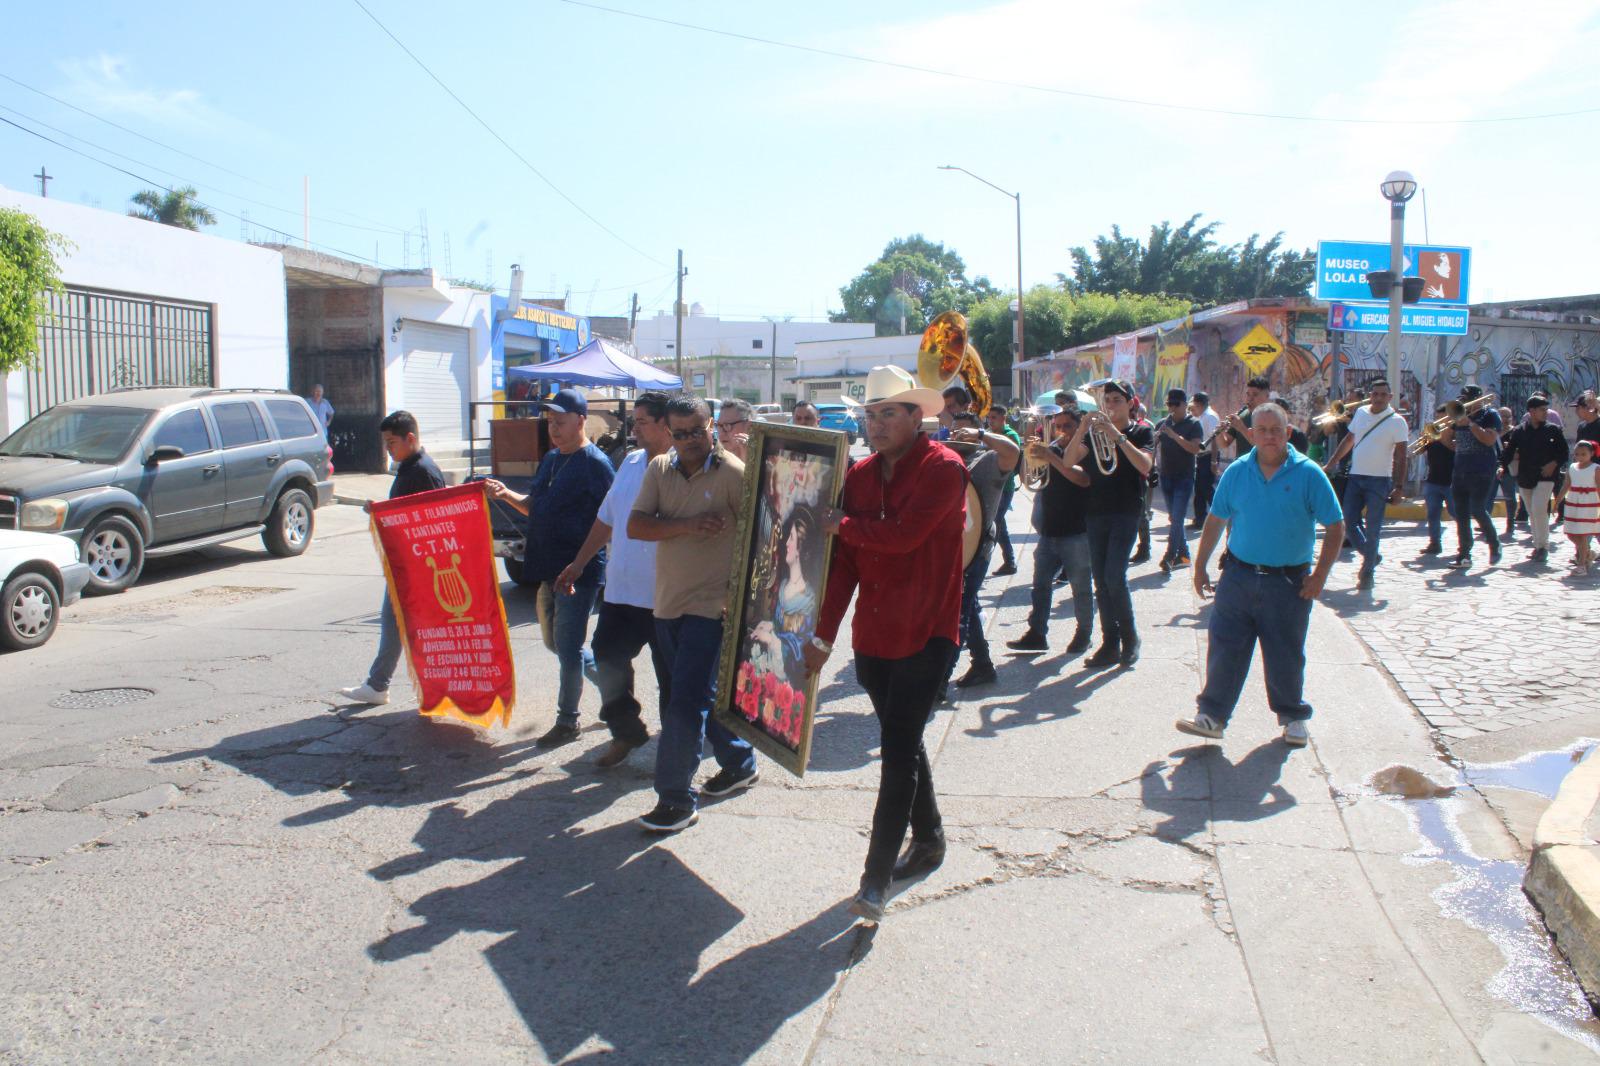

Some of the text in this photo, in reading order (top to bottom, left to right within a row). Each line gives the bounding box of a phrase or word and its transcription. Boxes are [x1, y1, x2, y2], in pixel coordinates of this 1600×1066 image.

[1325, 258, 1369, 270] MUSEO
[1325, 272, 1355, 283] LOLA
[1413, 315, 1436, 327] MIGUEL
[1437, 316, 1464, 327] HIDALGO
[411, 510, 421, 523] DE
[403, 521, 457, 540] Y CANTANTES
[417, 627, 447, 640] FUNDADO
[447, 626, 455, 638] EL
[463, 625, 471, 636] DE
[457, 640, 461, 650] A
[463, 639, 470, 650] LA
[426, 655, 435, 666] DE
